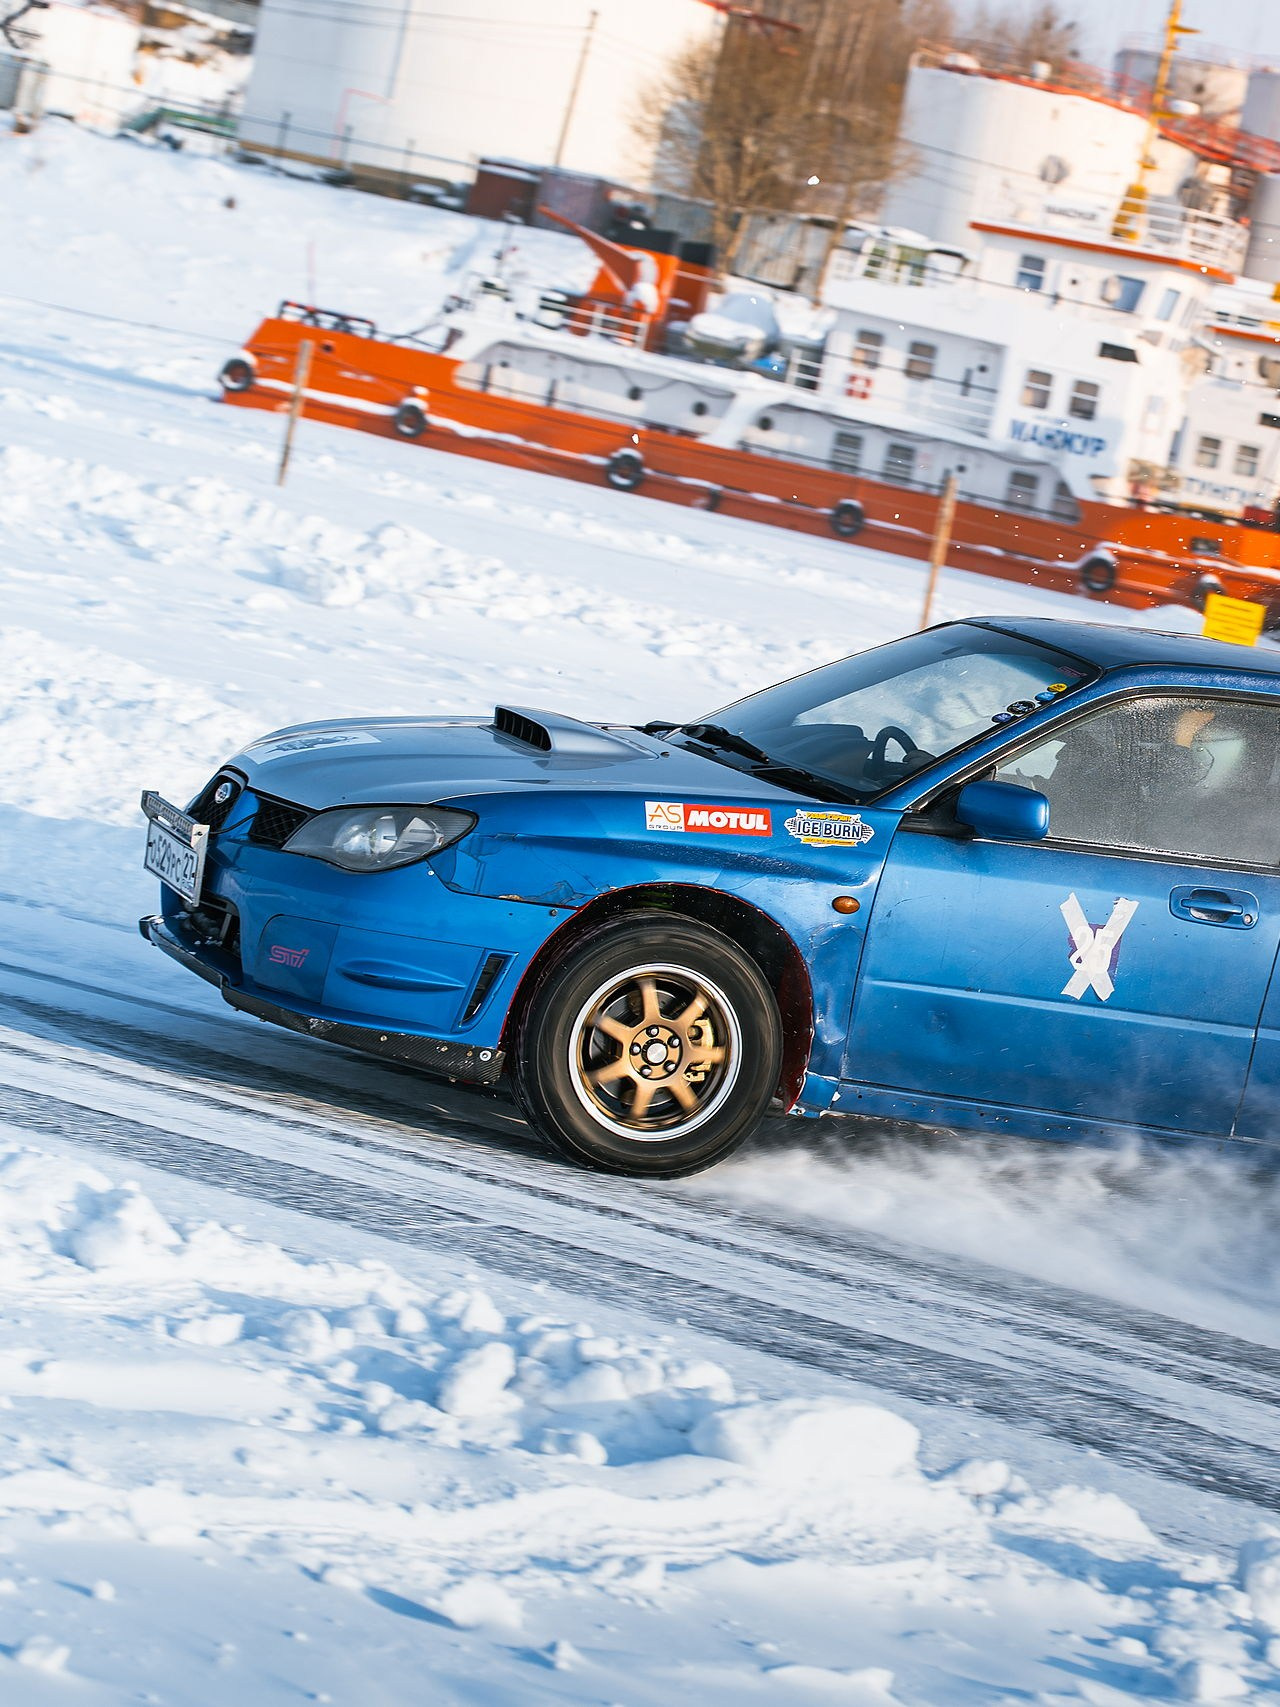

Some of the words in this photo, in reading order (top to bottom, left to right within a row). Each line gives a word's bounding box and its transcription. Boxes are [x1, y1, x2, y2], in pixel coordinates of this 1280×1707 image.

[648, 803, 682, 824] AS
[687, 809, 768, 832] MOTUL
[797, 820, 820, 835] ICE
[823, 822, 861, 839] BURN
[182, 852, 196, 881] 27
